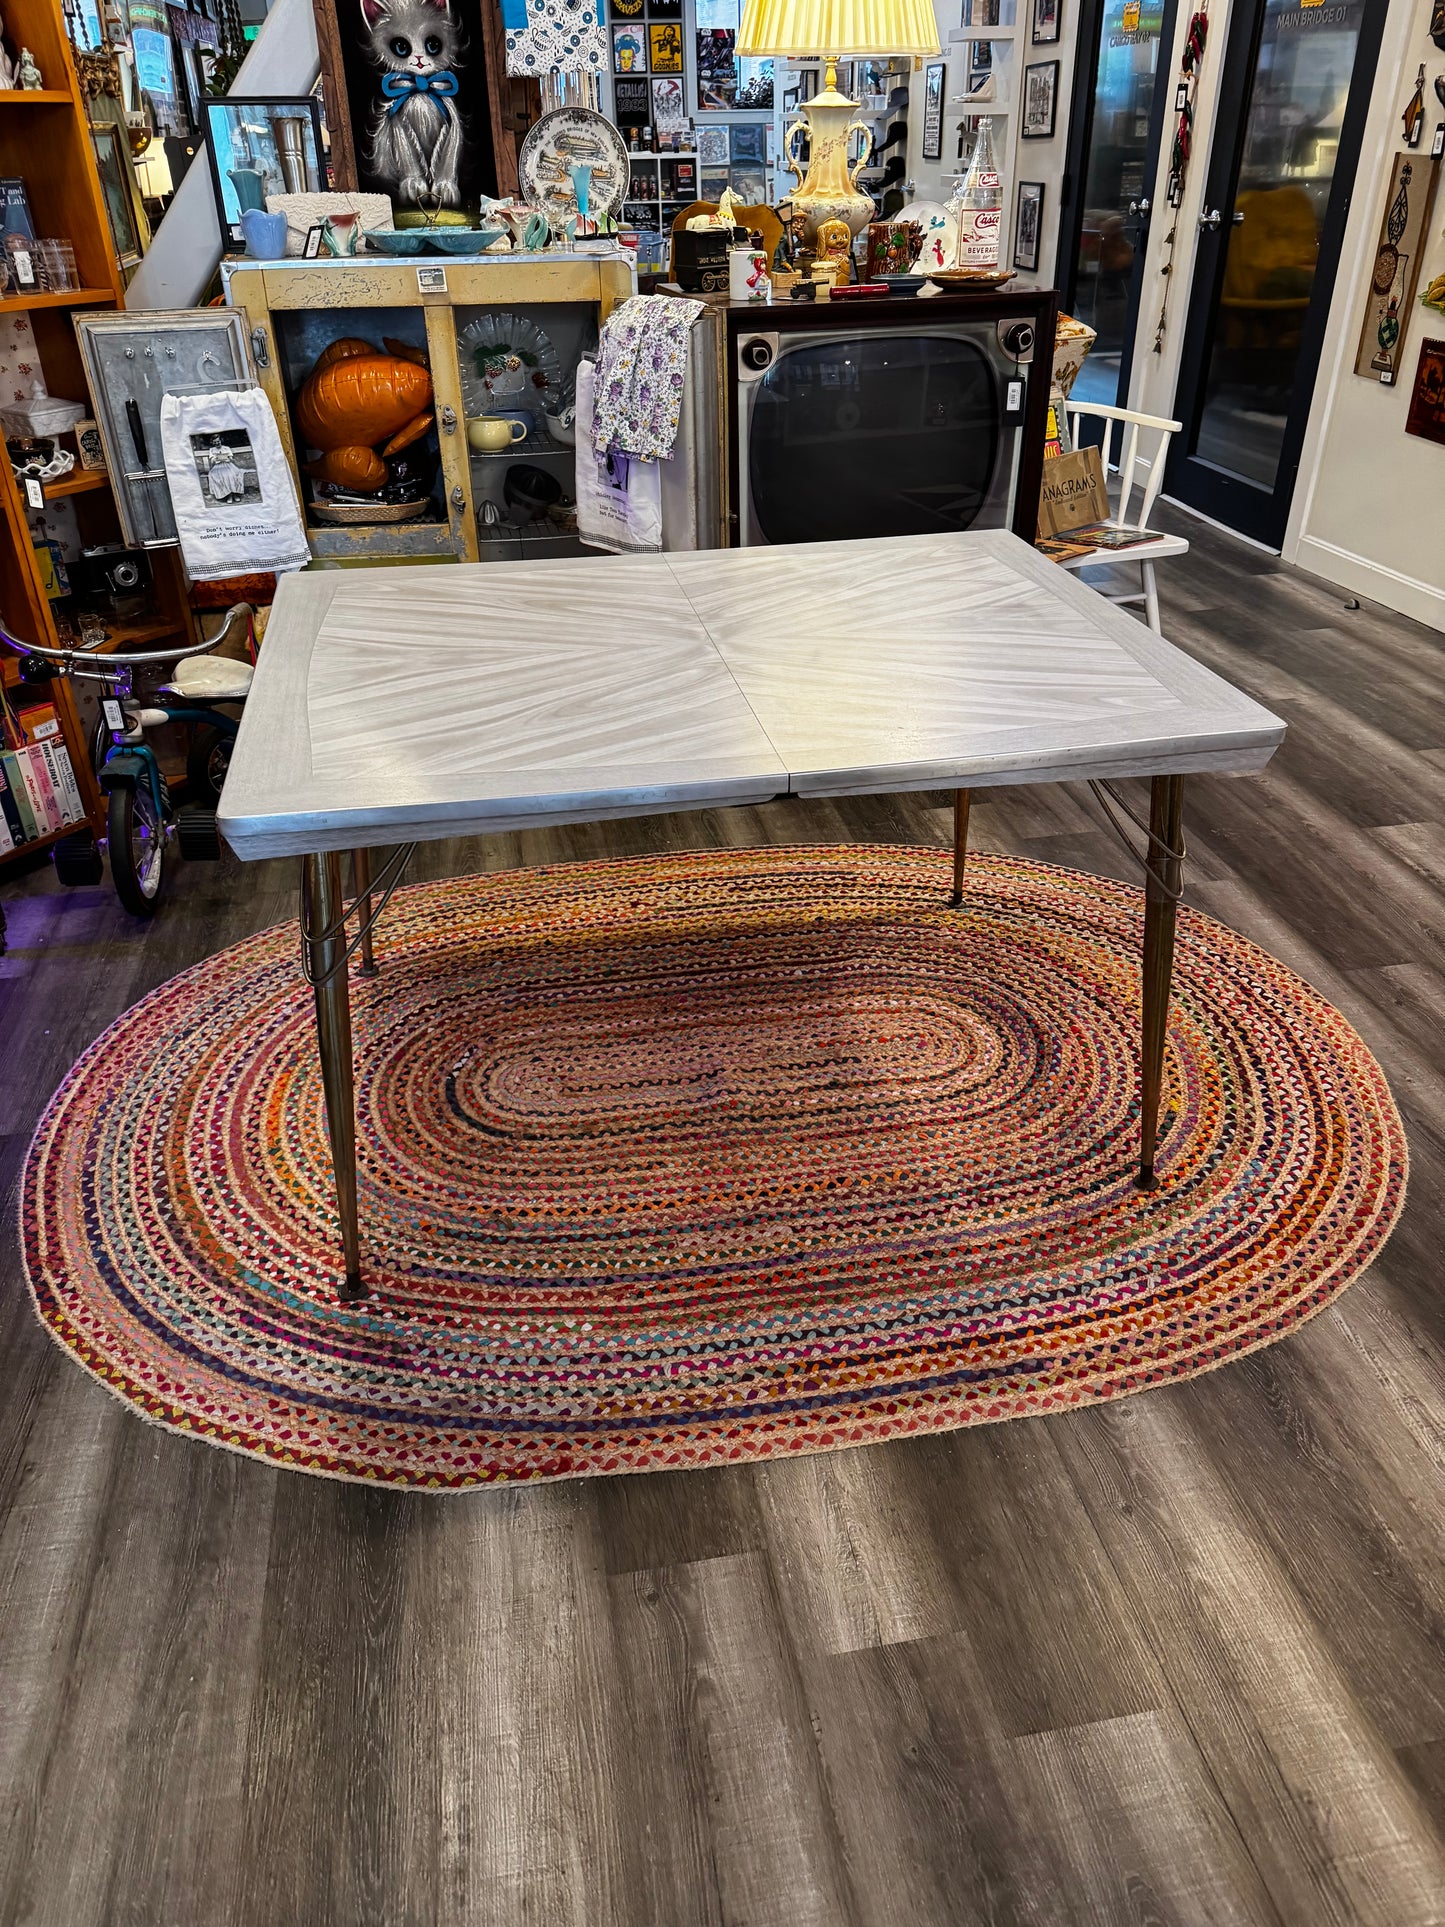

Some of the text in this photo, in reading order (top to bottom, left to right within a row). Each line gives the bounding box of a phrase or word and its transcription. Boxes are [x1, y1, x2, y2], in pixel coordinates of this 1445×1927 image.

[1276, 6, 1347, 29] MAIN BRIDGE 01
[617, 99, 647, 111] 1983
[8, 186, 23, 195] and
[7, 195, 26, 206] Lab
[1042, 473, 1097, 502] ANAGRAMS
[41, 743, 60, 788] HOUSEBOAT
